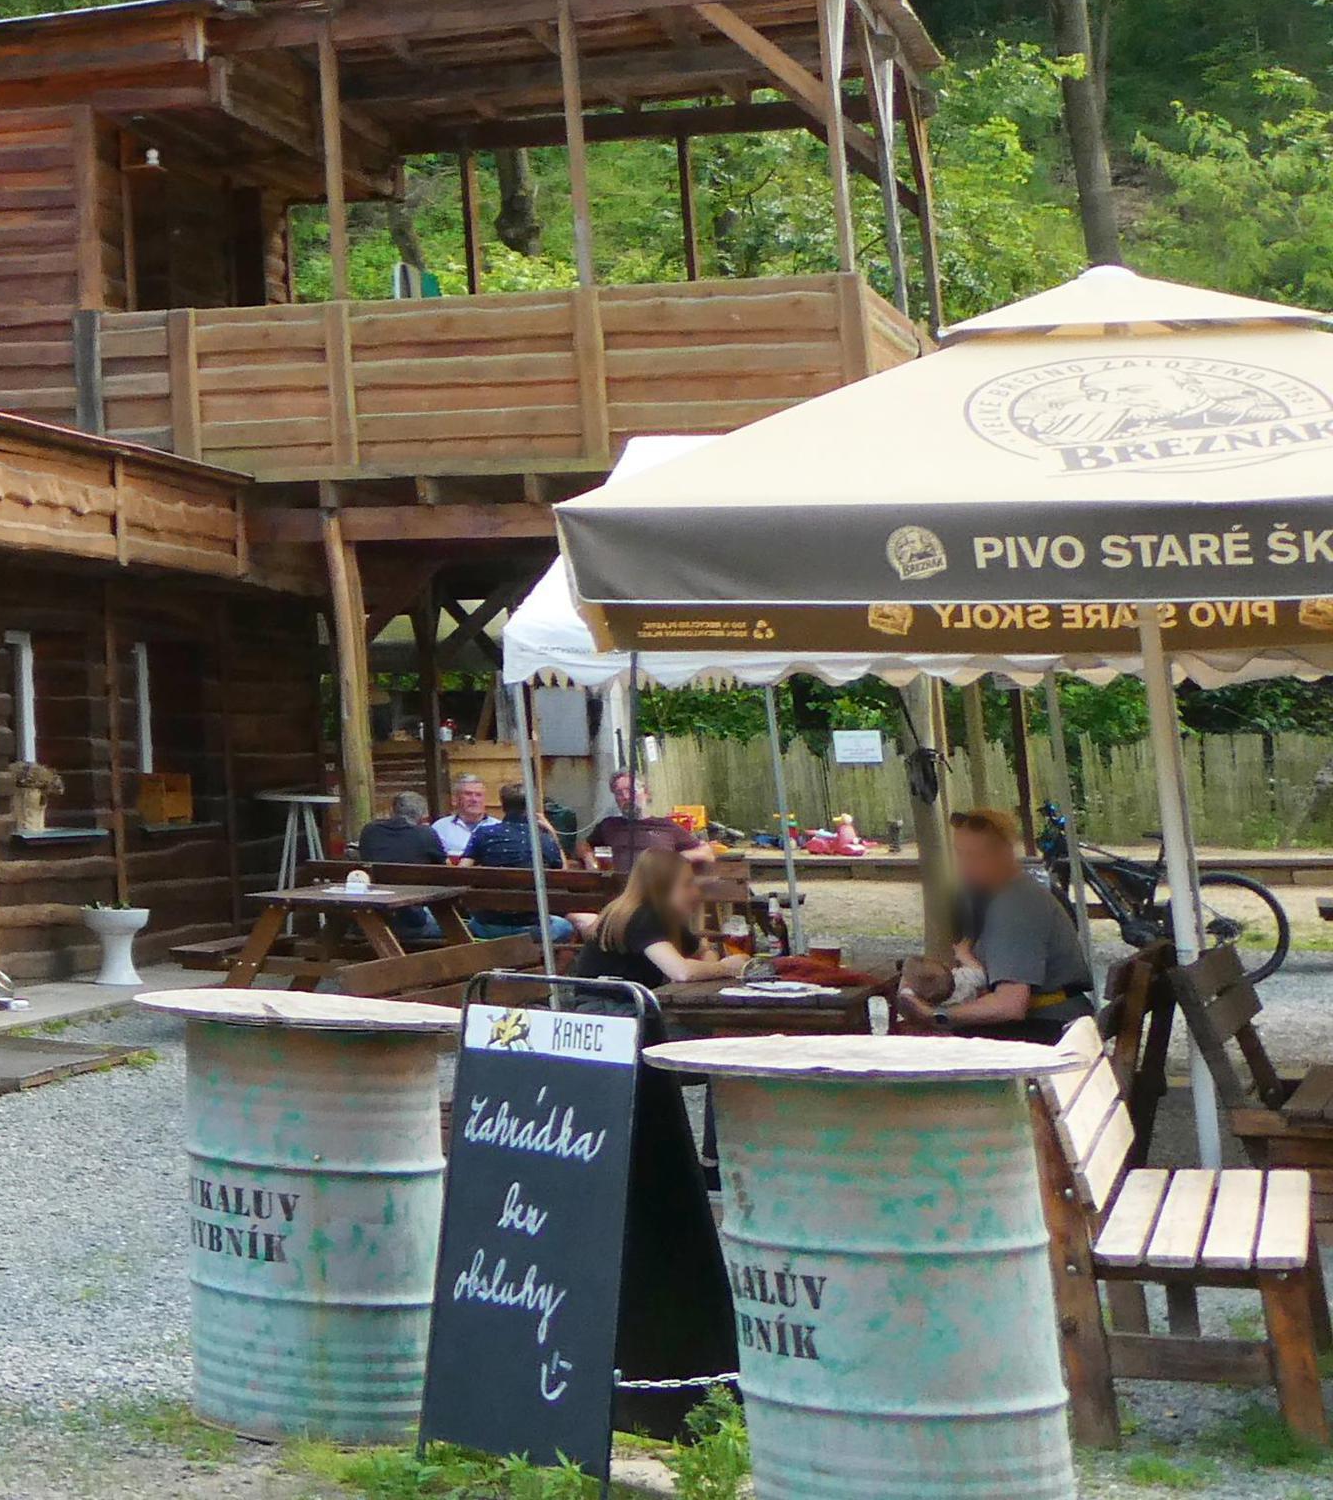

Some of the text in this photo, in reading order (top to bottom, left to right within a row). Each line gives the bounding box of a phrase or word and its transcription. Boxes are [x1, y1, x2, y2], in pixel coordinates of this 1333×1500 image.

[973, 535, 1085, 570] PIVO
[1101, 524, 1254, 569] STARÉ
[552, 1017, 604, 1052] KANEC
[464, 1086, 606, 1163] Zahrádka
[453, 1248, 566, 1344] obsluhy
